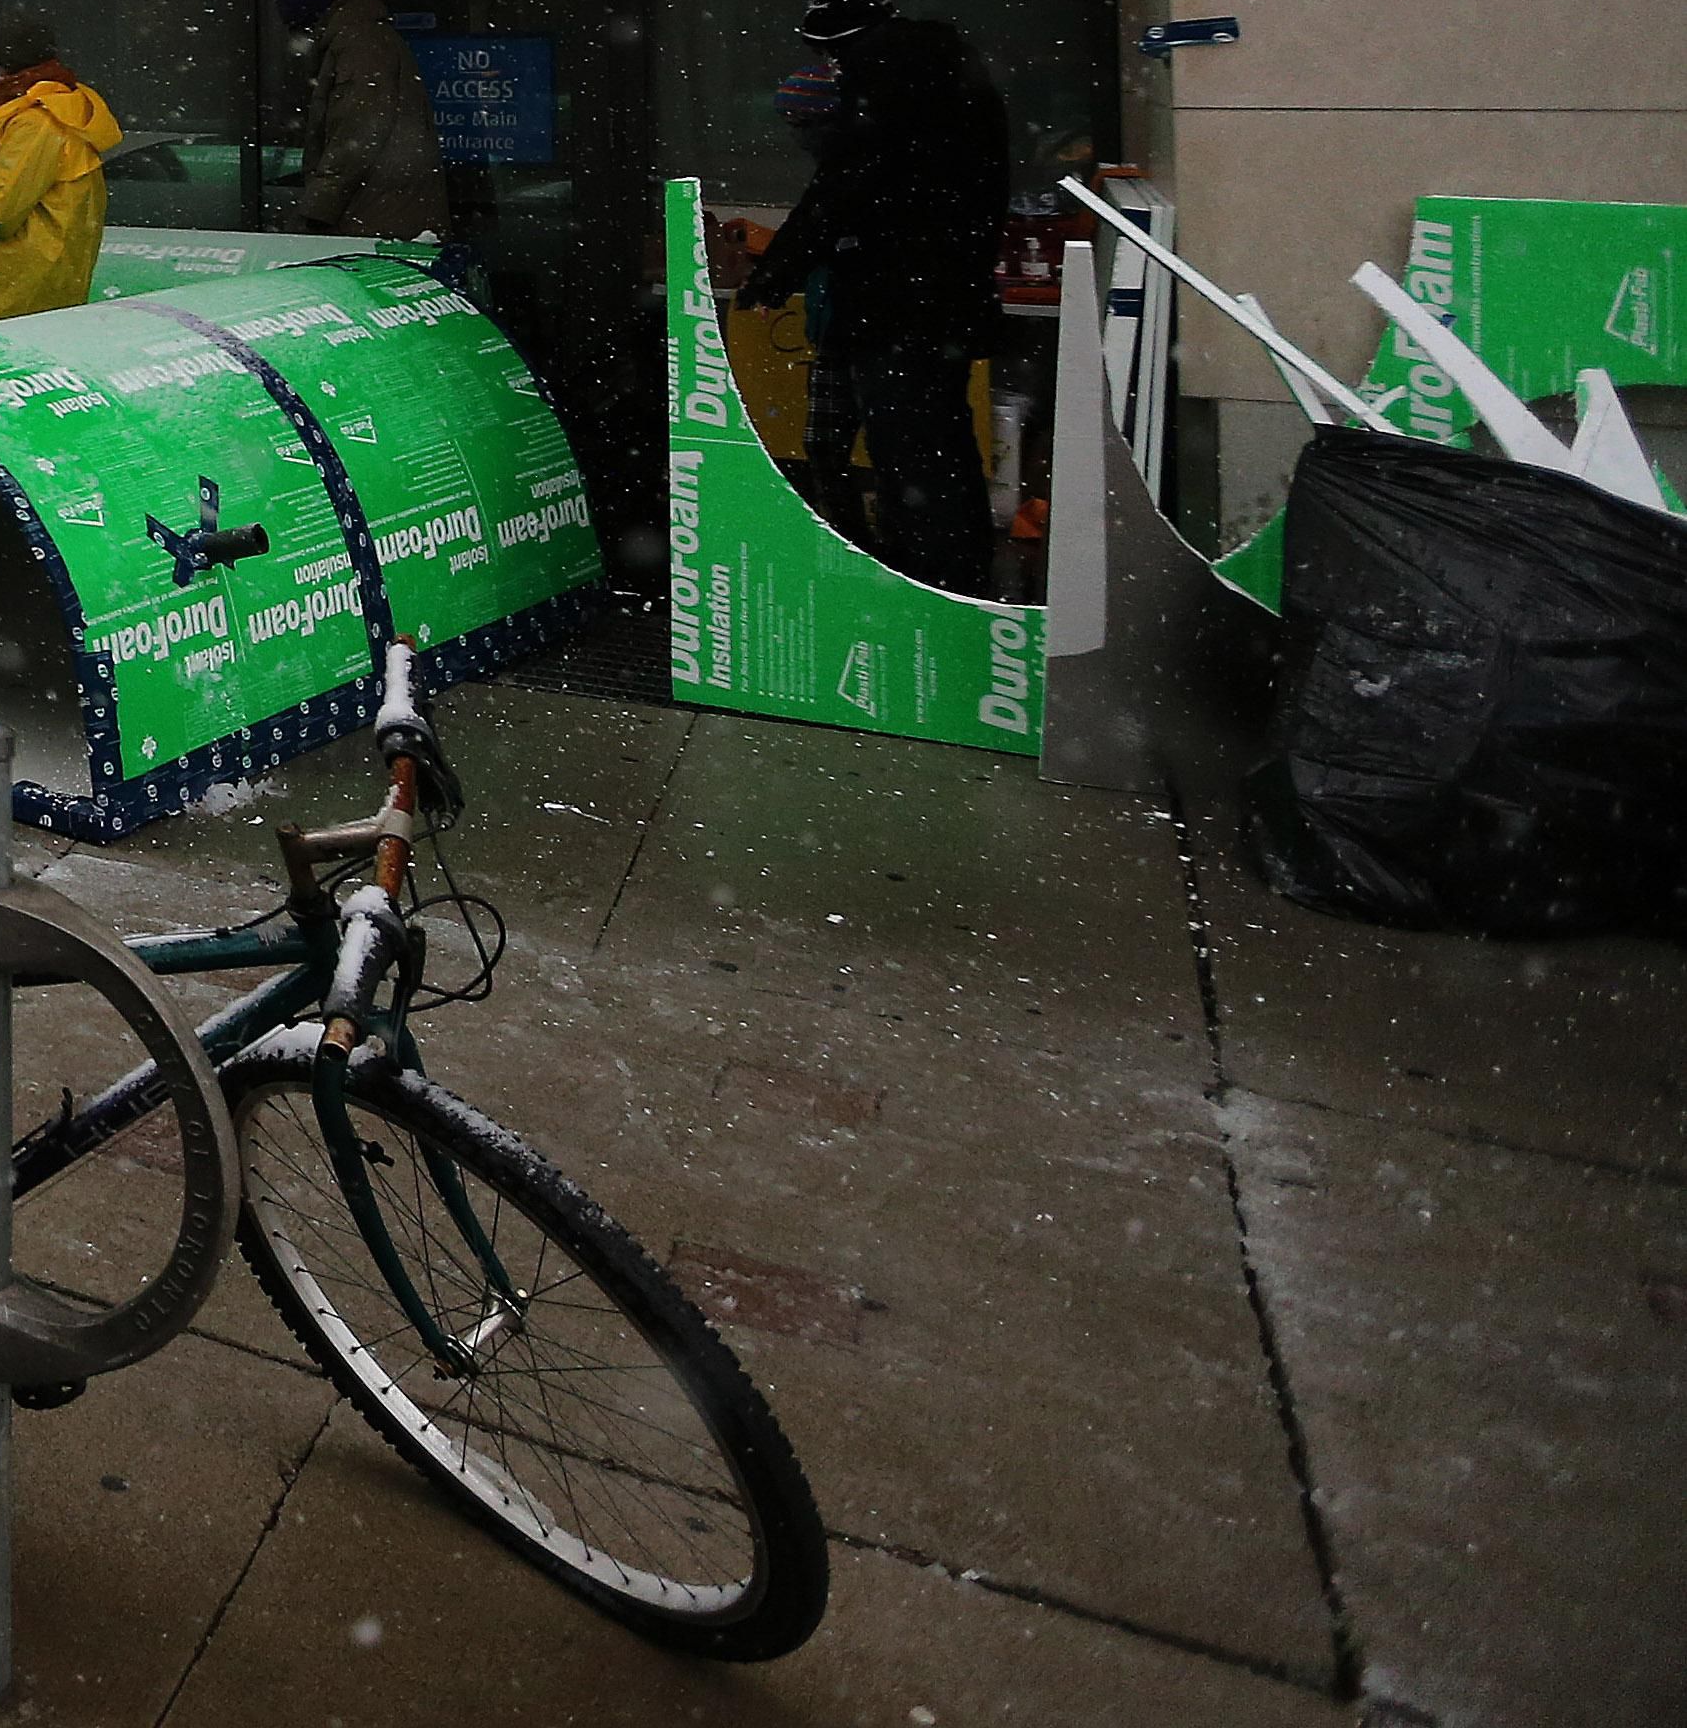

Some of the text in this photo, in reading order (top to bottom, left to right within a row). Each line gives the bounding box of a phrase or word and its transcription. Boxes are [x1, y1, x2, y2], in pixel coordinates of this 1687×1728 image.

[457, 50, 490, 71] NO
[434, 80, 514, 99] ACCESS
[433, 110, 517, 127] Use Main
[46, 391, 111, 419] Isolant
[374, 505, 483, 567] DuroFoam
[496, 493, 591, 550] DuroFoam
[294, 551, 352, 586] nsulation
[448, 543, 490, 576] Isolant
[705, 562, 732, 691] Insulation
